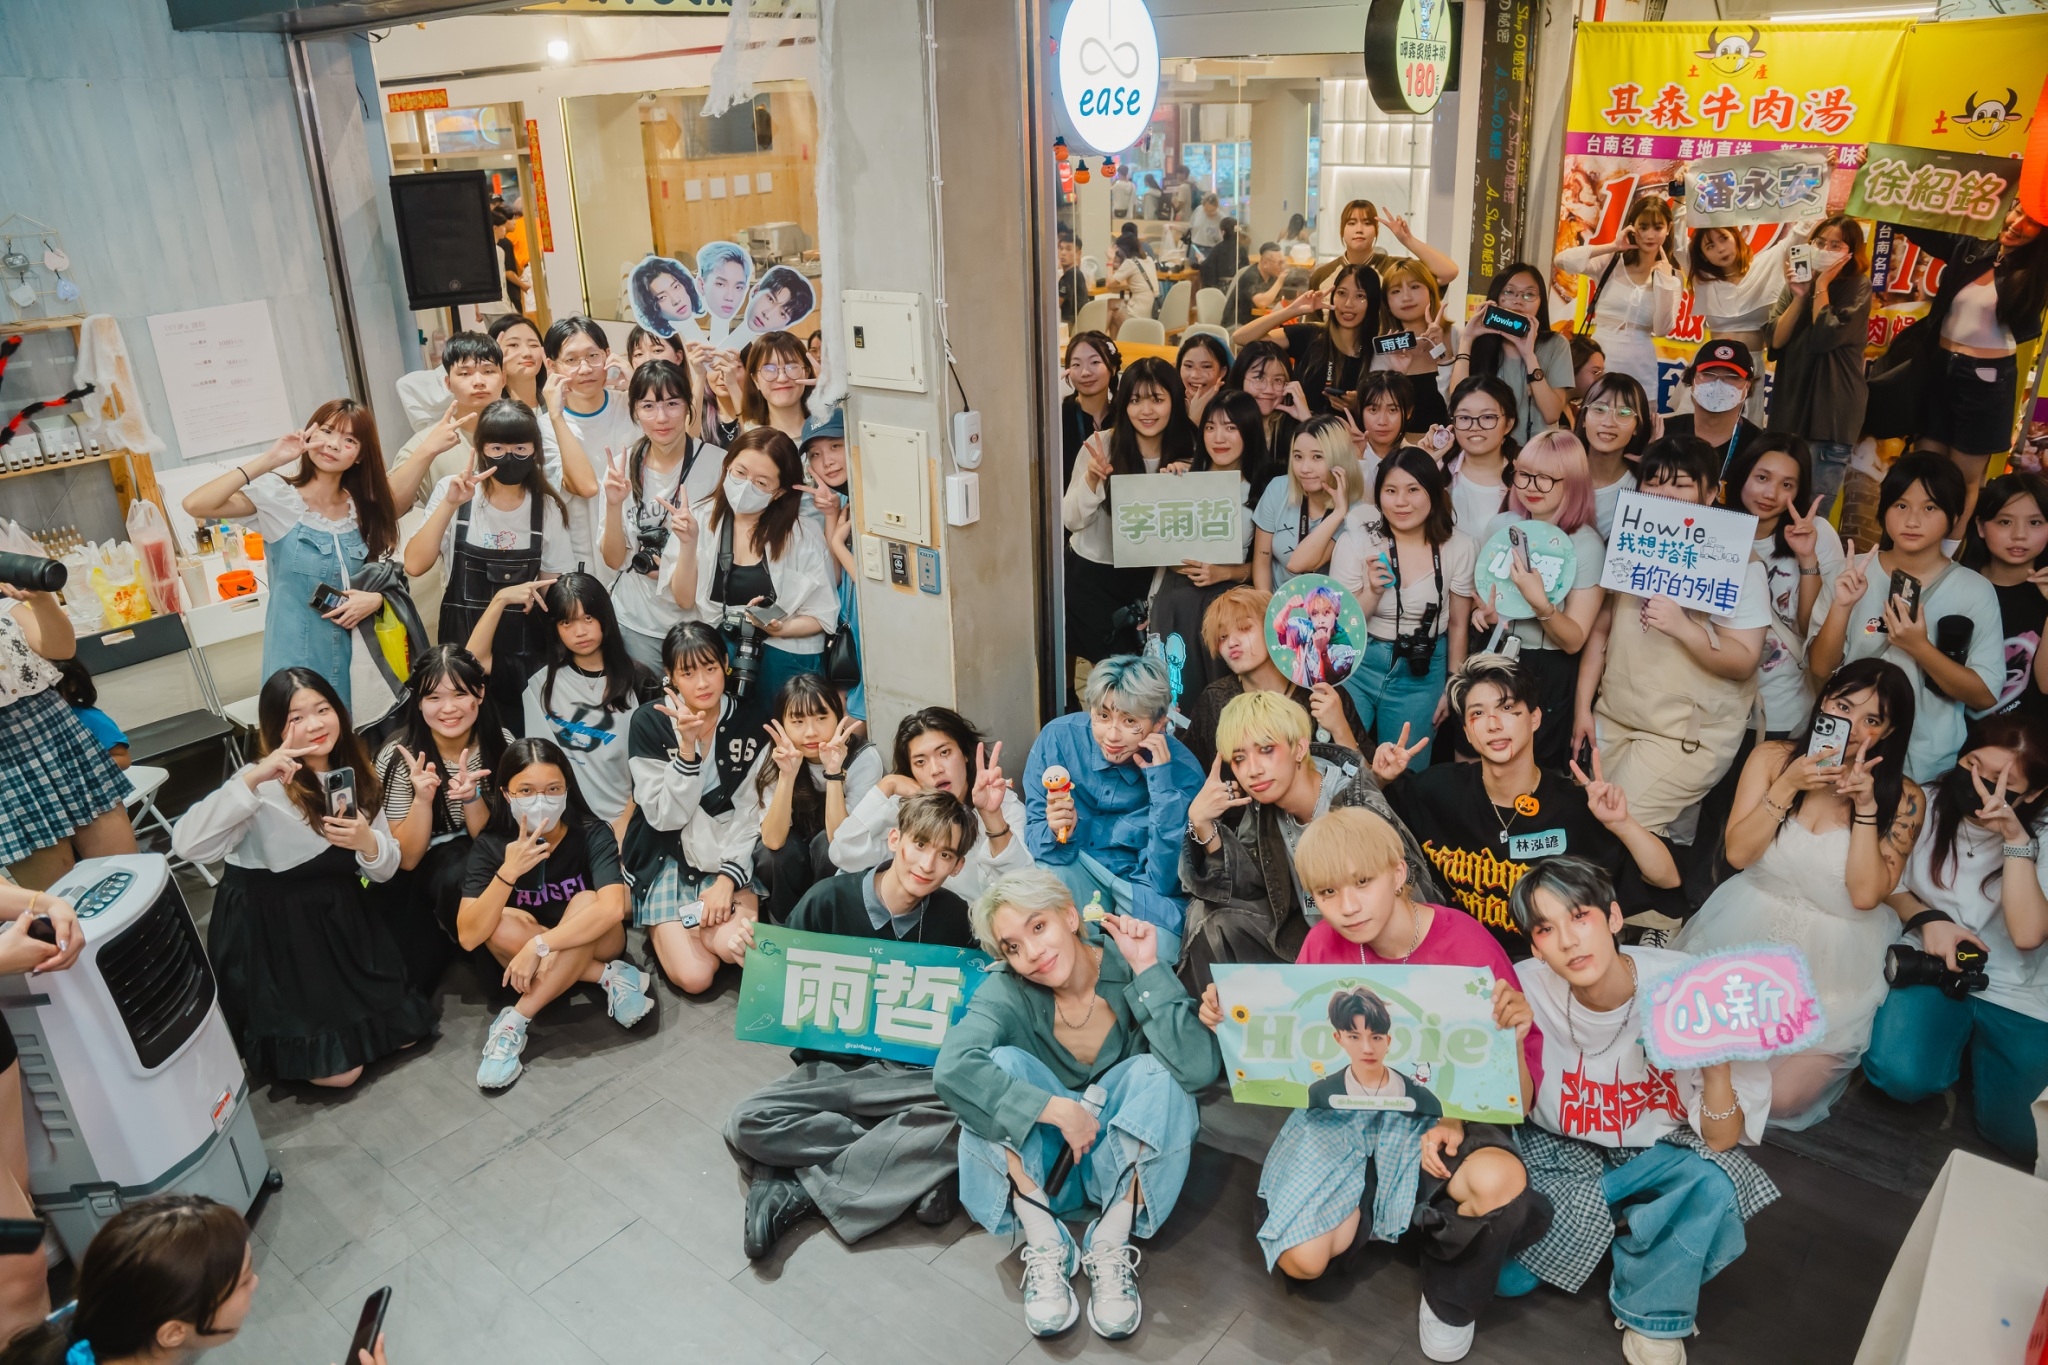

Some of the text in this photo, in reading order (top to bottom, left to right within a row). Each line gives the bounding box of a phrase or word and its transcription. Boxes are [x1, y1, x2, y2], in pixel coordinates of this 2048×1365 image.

[1406, 62, 1435, 97] 180
[1687, 64, 1700, 78] 土
[1079, 86, 1140, 116] ease
[1603, 83, 1855, 133] 其森牛肉湯
[1931, 110, 1948, 134] 土
[1586, 135, 1753, 159] 台南名產 產地直送
[1694, 163, 1824, 213] 潘永安
[1864, 157, 2007, 222] 徐紹銘
[1872, 224, 1893, 287] 台南名產
[1490, 312, 1513, 328] Howie
[1380, 337, 1410, 352] 雨哲
[1118, 498, 1236, 542] 李雨哲
[1621, 504, 1706, 544] Howie
[1617, 531, 1699, 570] 我想搭乘
[1630, 562, 1740, 611] 有你的列車
[728, 737, 757, 763] 96
[1516, 834, 1560, 852] 林泓諺
[869, 947, 883, 955] LYC
[781, 947, 963, 1047] 雨哲
[1675, 974, 1785, 1034] 小新
[1758, 997, 1819, 1050] LOVE
